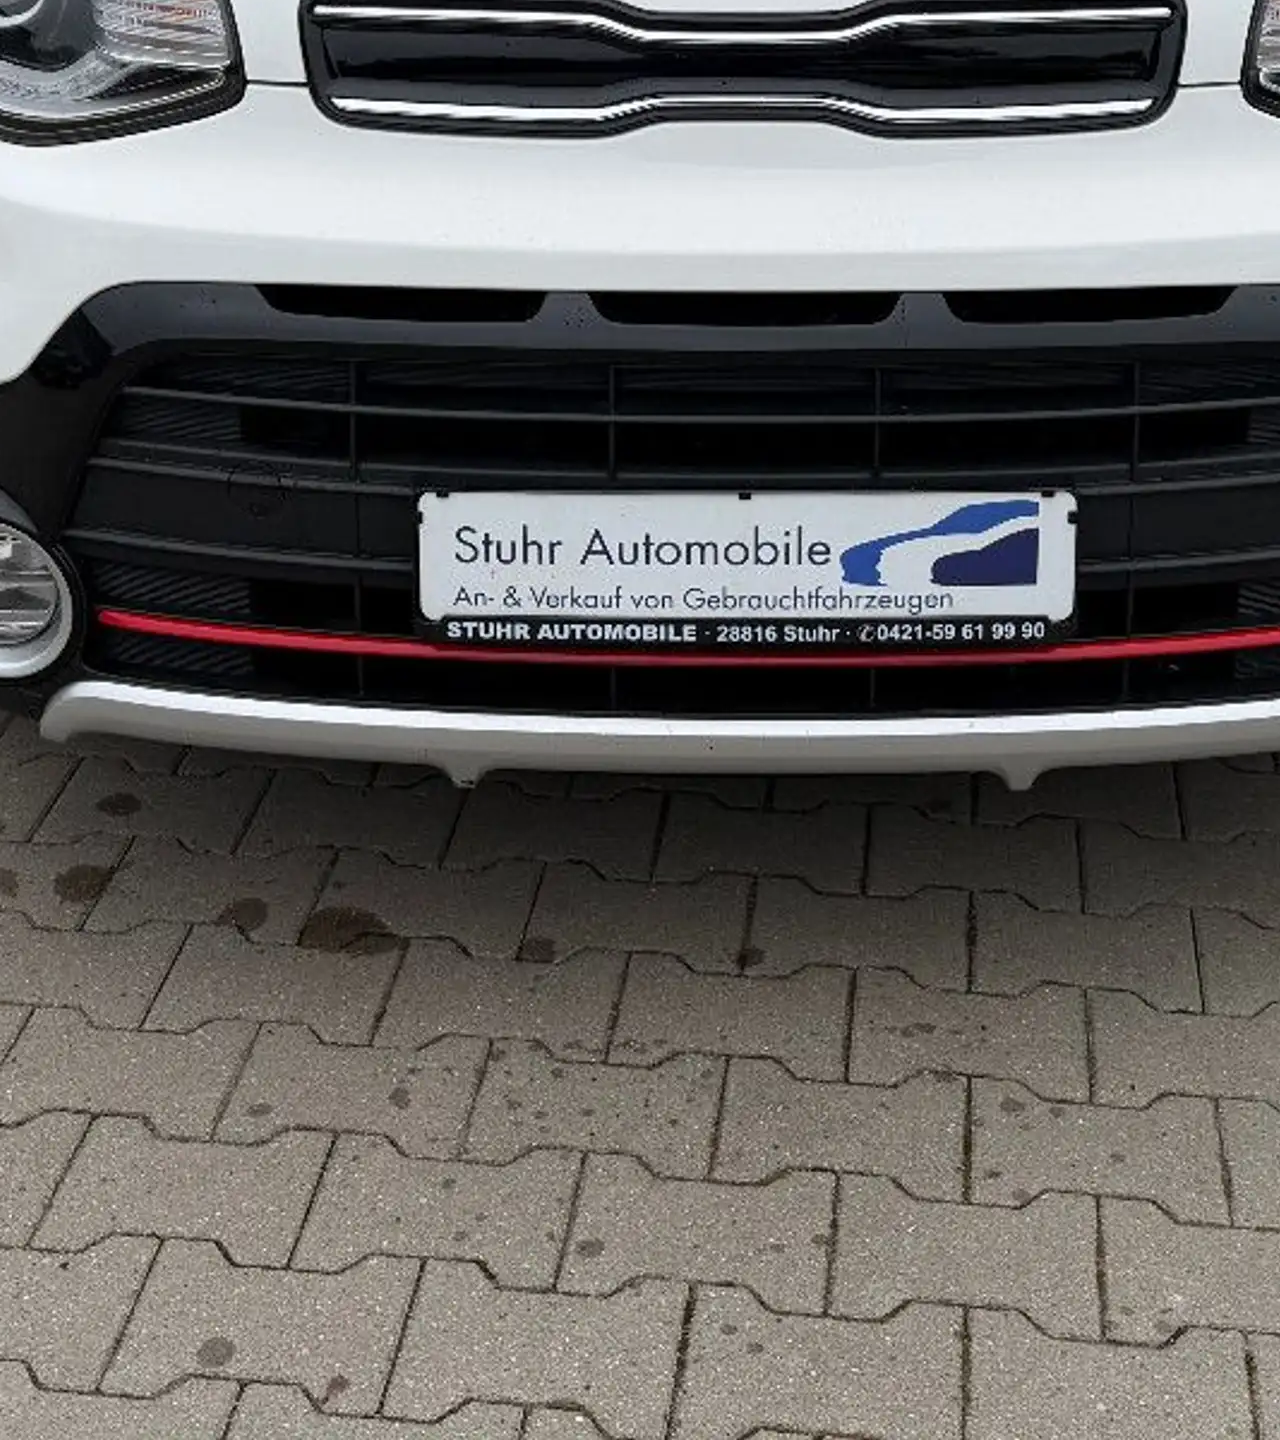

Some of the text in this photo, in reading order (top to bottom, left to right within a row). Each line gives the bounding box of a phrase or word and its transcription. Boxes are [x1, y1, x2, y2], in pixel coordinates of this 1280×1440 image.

[454, 523, 832, 566] Stuhr Automobile
[452, 585, 954, 616] An- & Verkauf von Gebrauchtfahrzeugen
[446, 620, 533, 641] STUHR
[536, 622, 698, 643] AUTOMOBILE
[716, 623, 778, 643] 28816
[783, 623, 840, 643] Stuhr
[1020, 621, 1046, 639] 90
